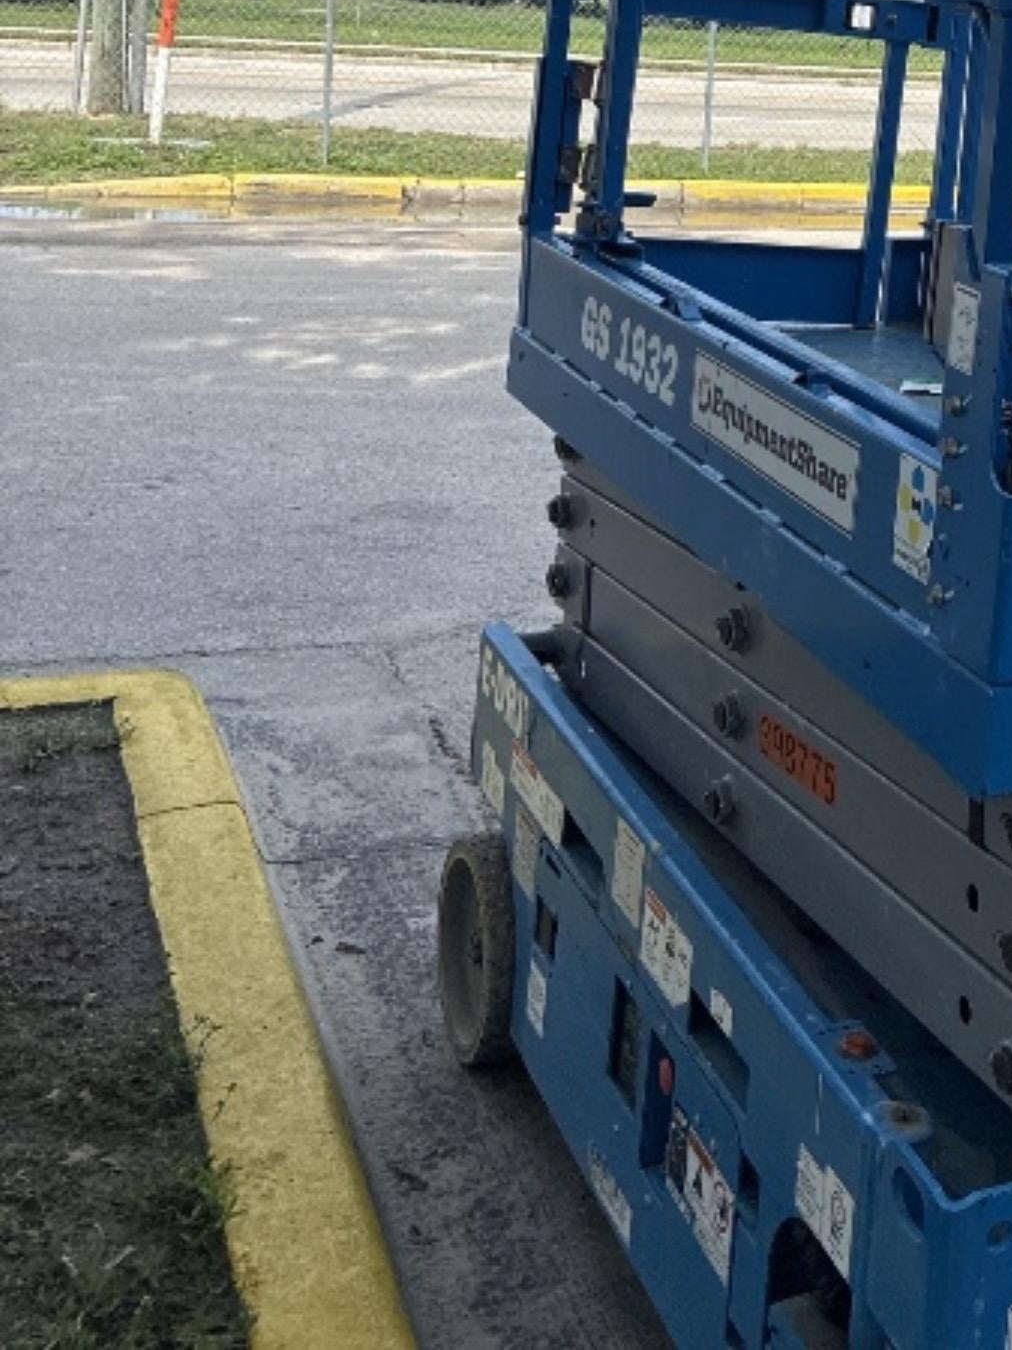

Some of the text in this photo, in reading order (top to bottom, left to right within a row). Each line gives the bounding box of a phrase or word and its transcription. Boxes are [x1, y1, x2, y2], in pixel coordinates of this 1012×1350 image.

[581, 295, 678, 406] GS 1932
[713, 383, 848, 501] EquipmentShare
